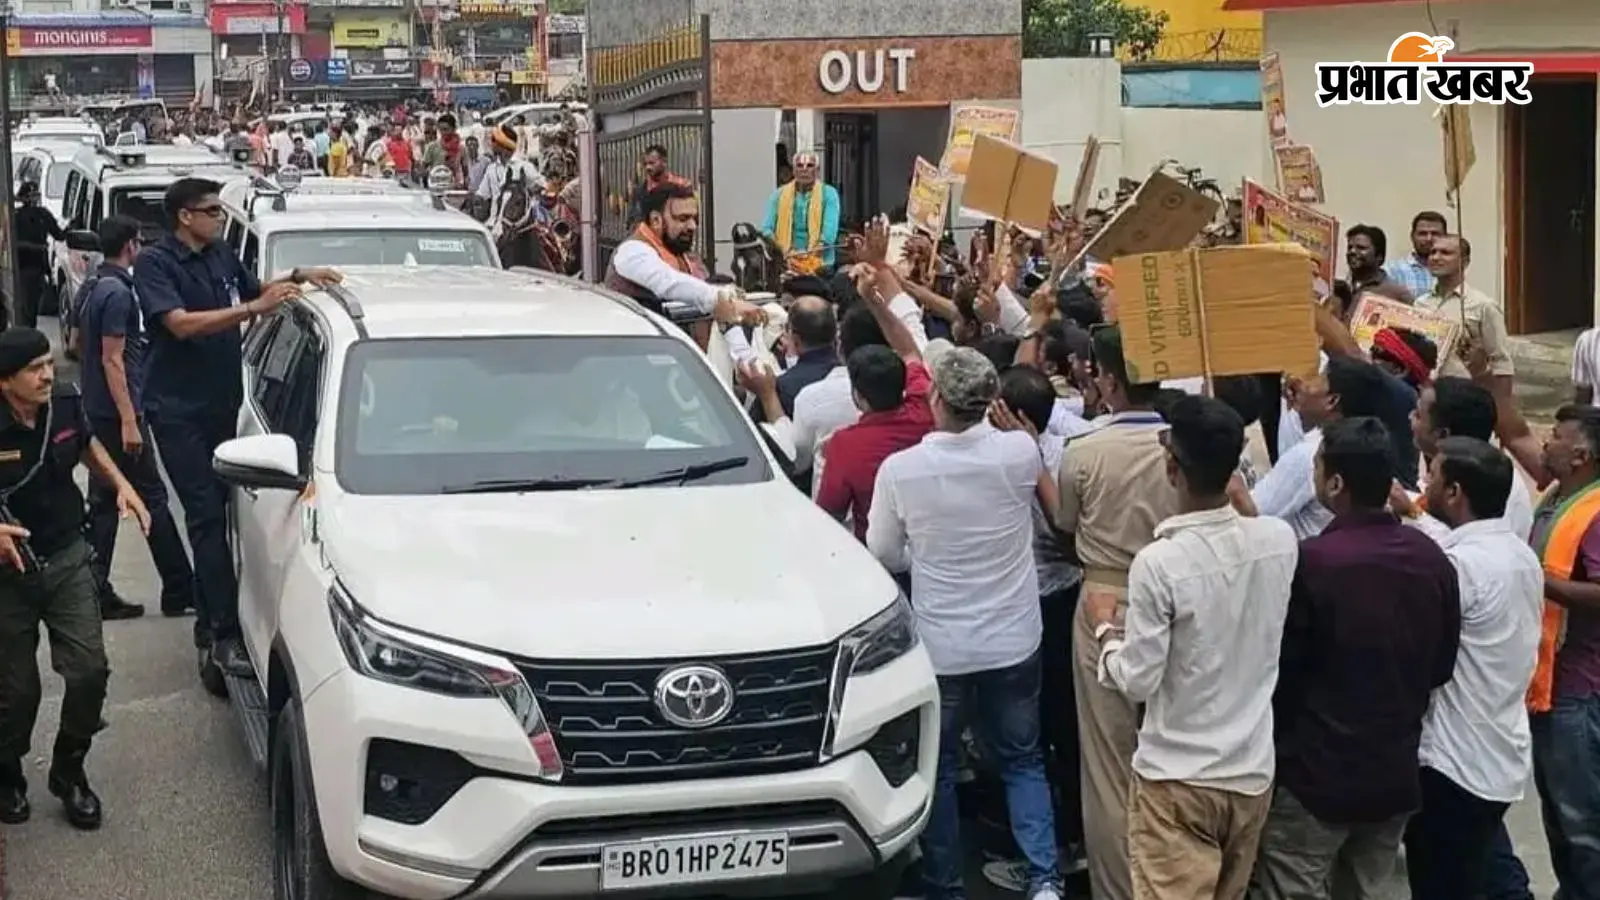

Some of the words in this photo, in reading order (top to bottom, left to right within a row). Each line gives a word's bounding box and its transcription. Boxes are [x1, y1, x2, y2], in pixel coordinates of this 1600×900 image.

[820, 48, 916, 92] OUT
[1142, 256, 1167, 354] VITRIFIED
[1154, 361, 1170, 379] D
[621, 838, 785, 878] BR01HP2475
